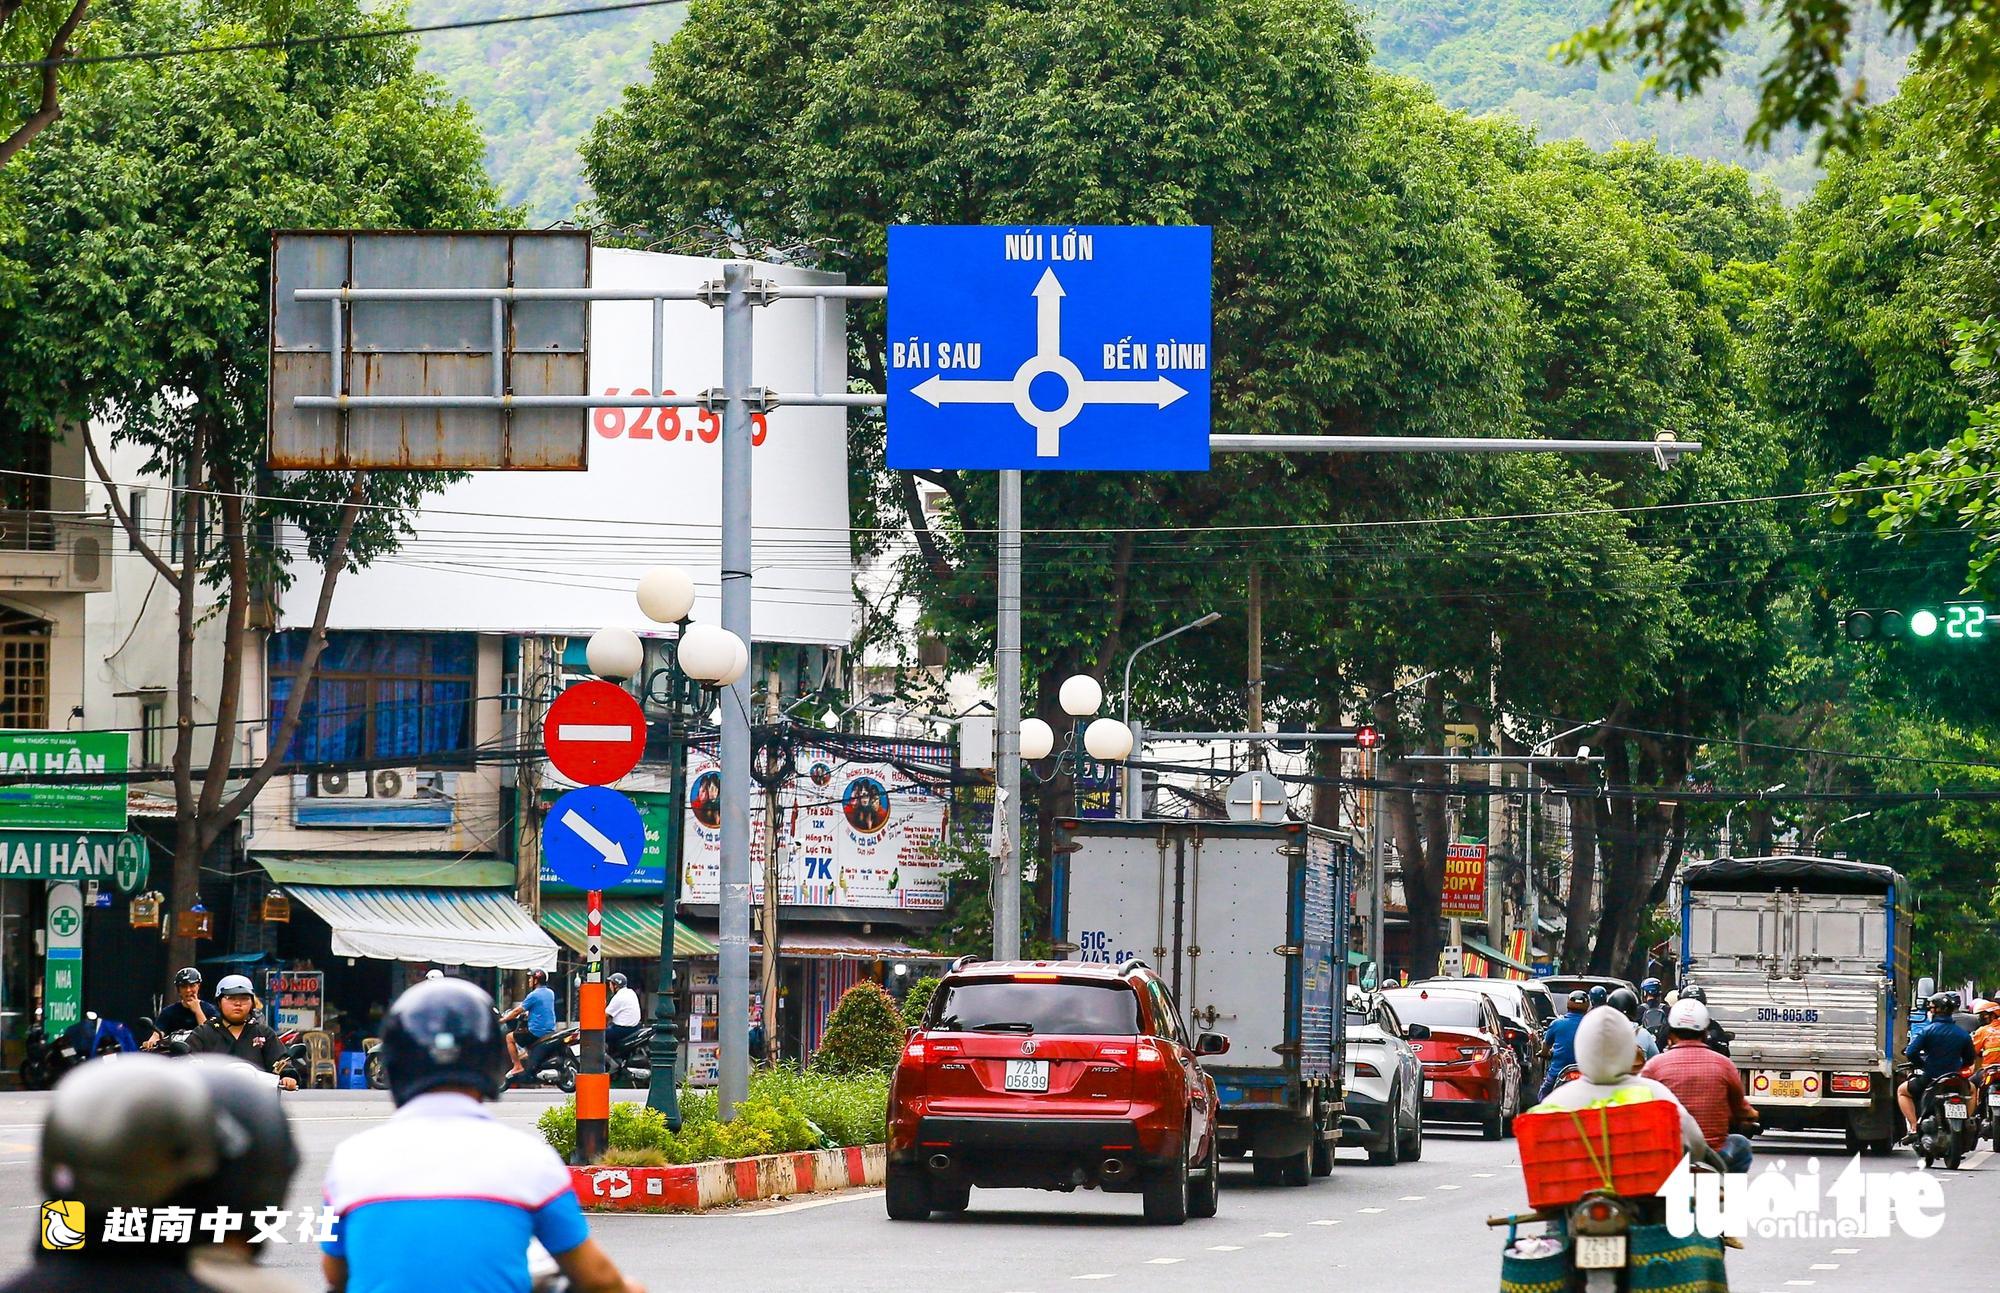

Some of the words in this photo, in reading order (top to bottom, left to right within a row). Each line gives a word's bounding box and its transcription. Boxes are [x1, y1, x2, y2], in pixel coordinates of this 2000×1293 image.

[1005, 229, 1043, 261] NÚI
[1051, 228, 1093, 261] LỚN
[893, 336, 930, 368] BÃI
[938, 342, 982, 369] SAU
[1103, 336, 1147, 370] BẾN
[1156, 339, 1206, 370] ĐÌNH
[1946, 606, 1985, 638] 22
[44, 748, 105, 775] HÂN
[812, 820, 825, 828] 12K
[50, 836, 114, 875] HÂN
[805, 857, 832, 879] 7K
[1446, 861, 1482, 874] HOTO
[1081, 931, 1112, 949] 51C-
[49, 995, 77, 1021] THUỐC
[1758, 1008, 1818, 1022] 50H-805.85
[1015, 1061, 1038, 1075] 72A
[1007, 1075, 1047, 1089] 058.99
[1773, 1088, 1800, 1097] 805.85
